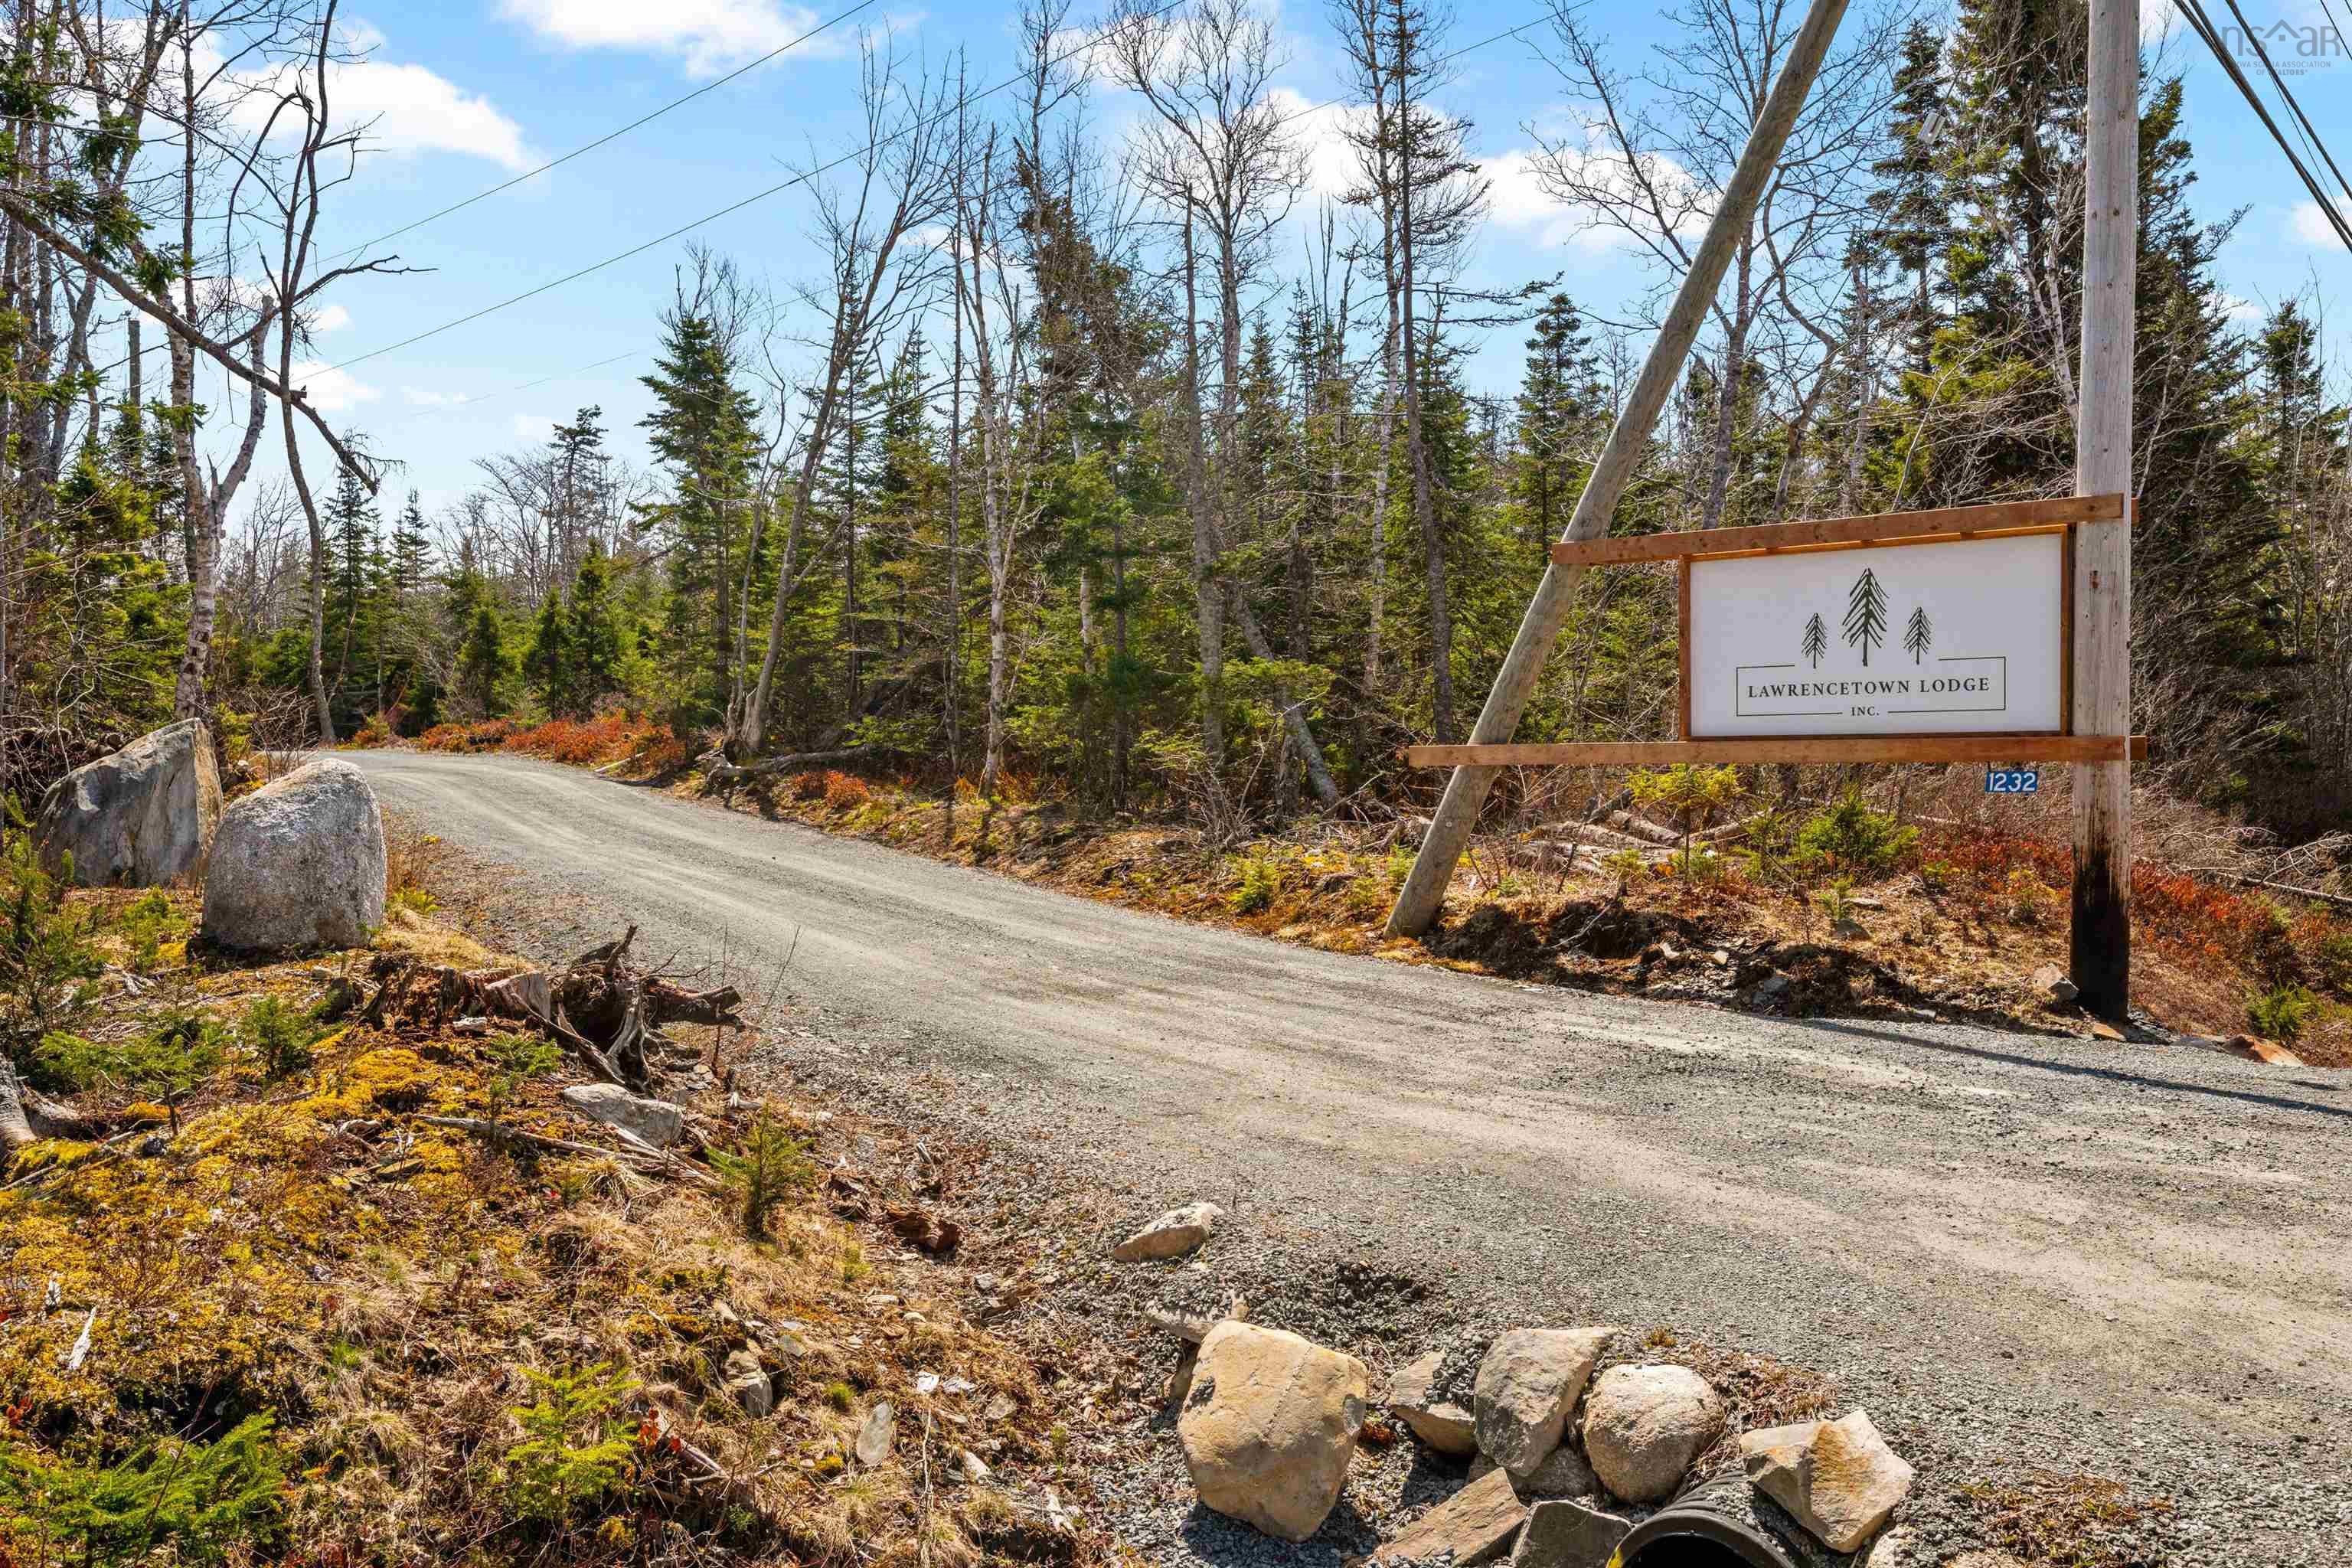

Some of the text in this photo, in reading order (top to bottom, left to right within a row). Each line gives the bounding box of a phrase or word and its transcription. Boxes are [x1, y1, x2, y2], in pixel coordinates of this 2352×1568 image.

[1748, 677, 1991, 698] LAWRENCETOWN LODGE
[1851, 706, 1880, 717] INC.
[1988, 772, 2036, 792] 1232
